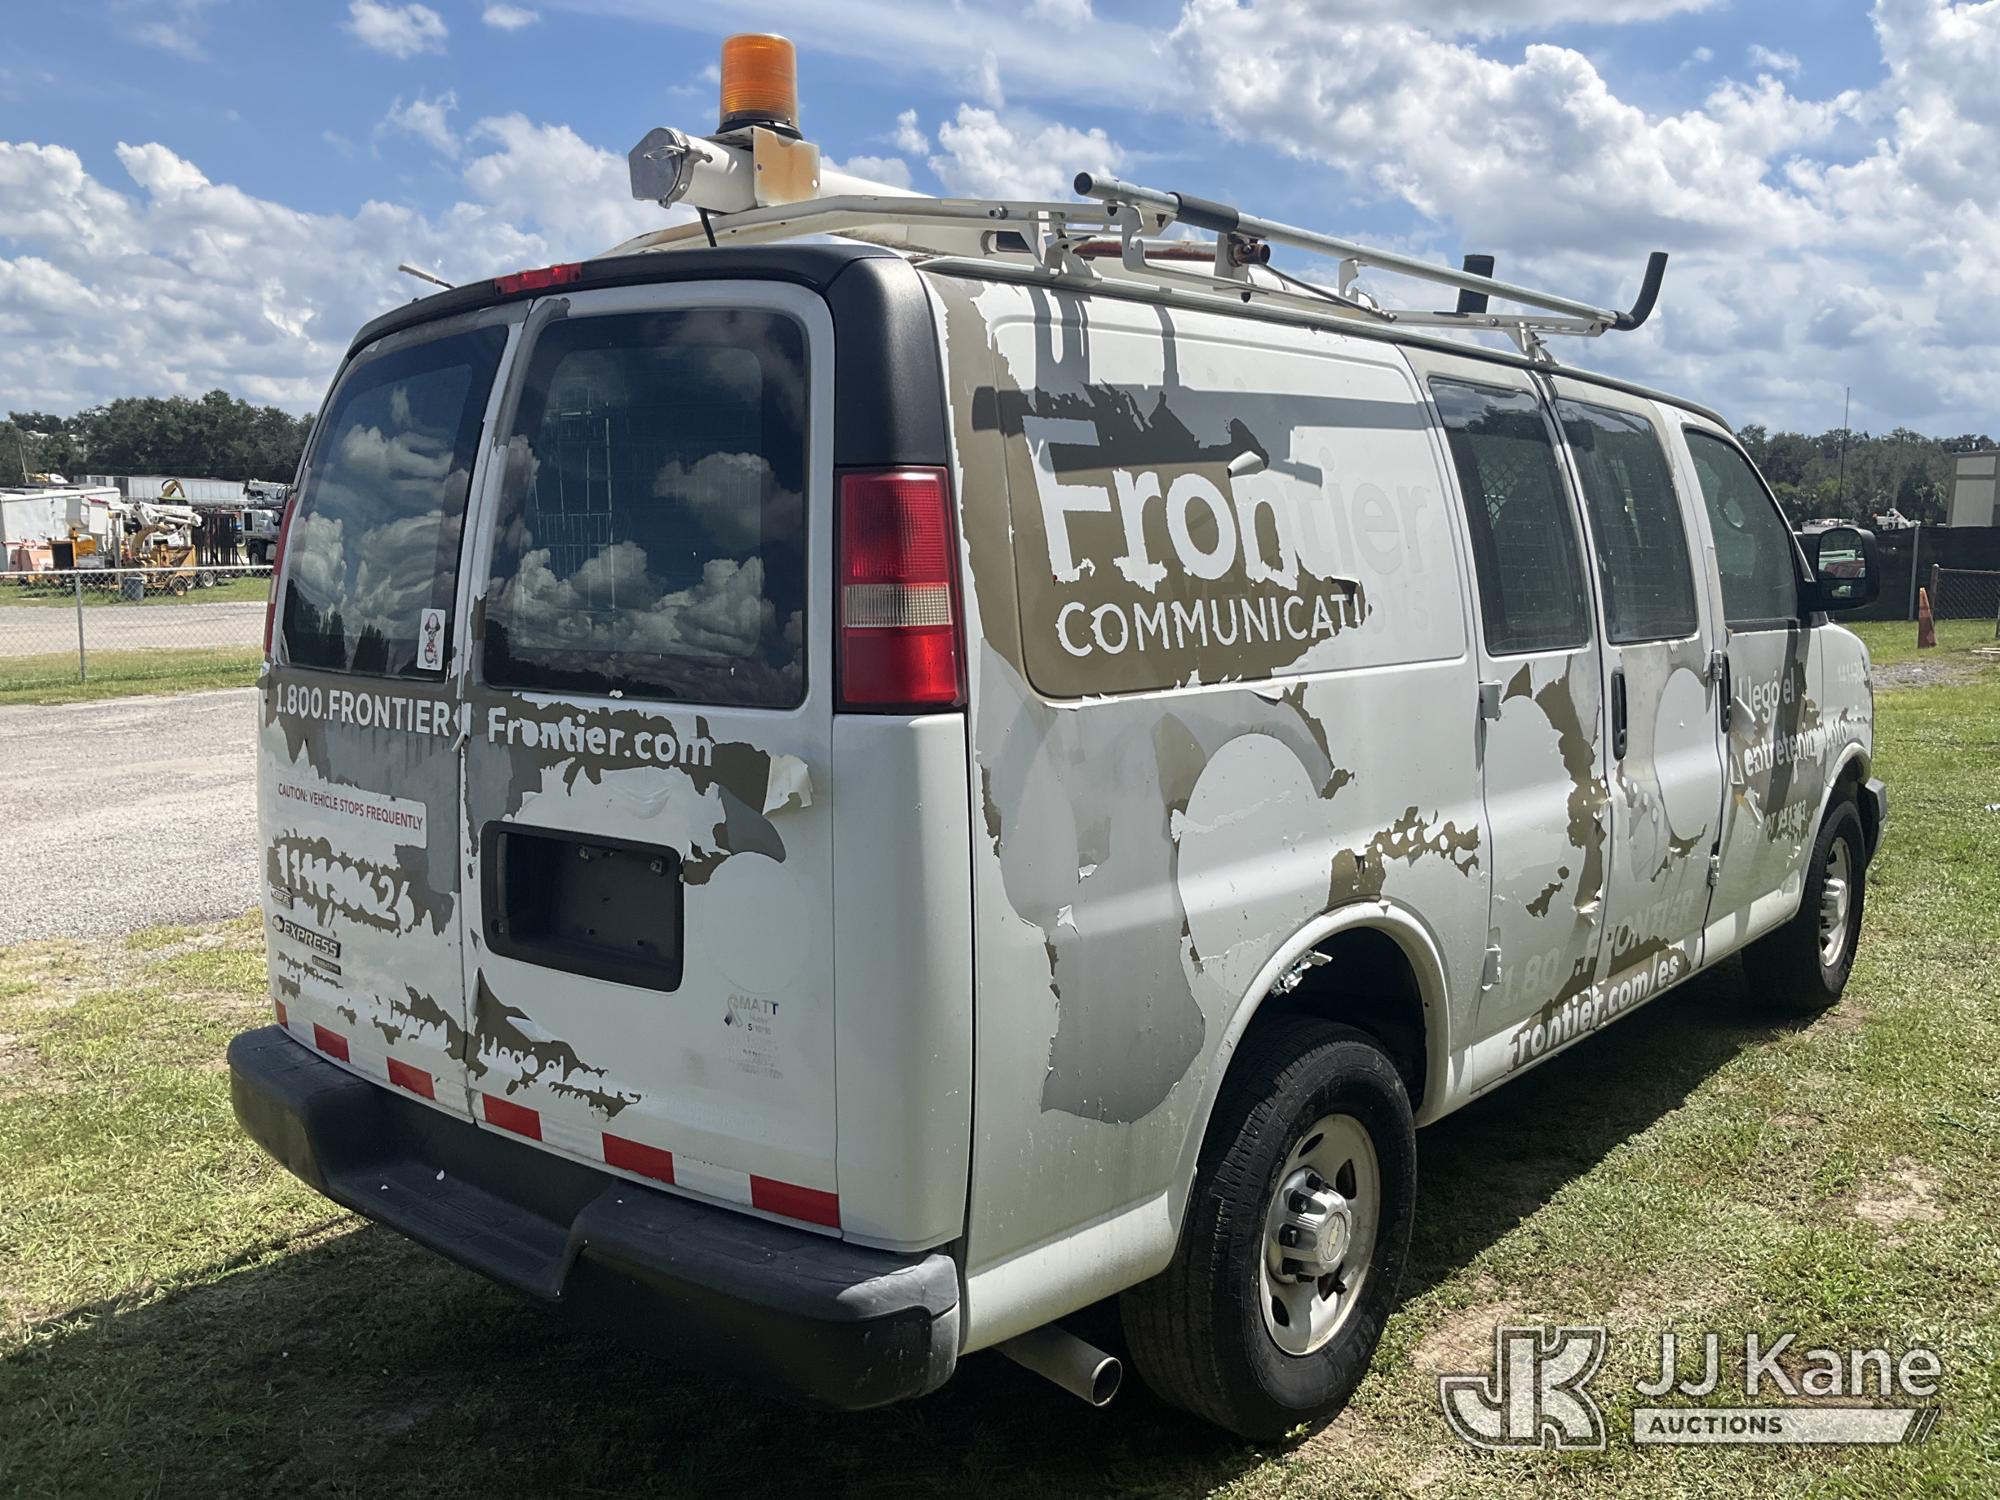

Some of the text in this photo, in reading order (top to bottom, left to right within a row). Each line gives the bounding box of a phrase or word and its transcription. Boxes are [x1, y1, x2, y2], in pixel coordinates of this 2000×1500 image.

[1021, 415, 1429, 594] Frontier
[1783, 667, 1795, 704] el
[487, 706, 713, 767] Frontier.com
[278, 783, 423, 831] CAUTION: VEHICLE STOPS FREQUENTLY
[283, 921, 339, 957] EXPRESS
